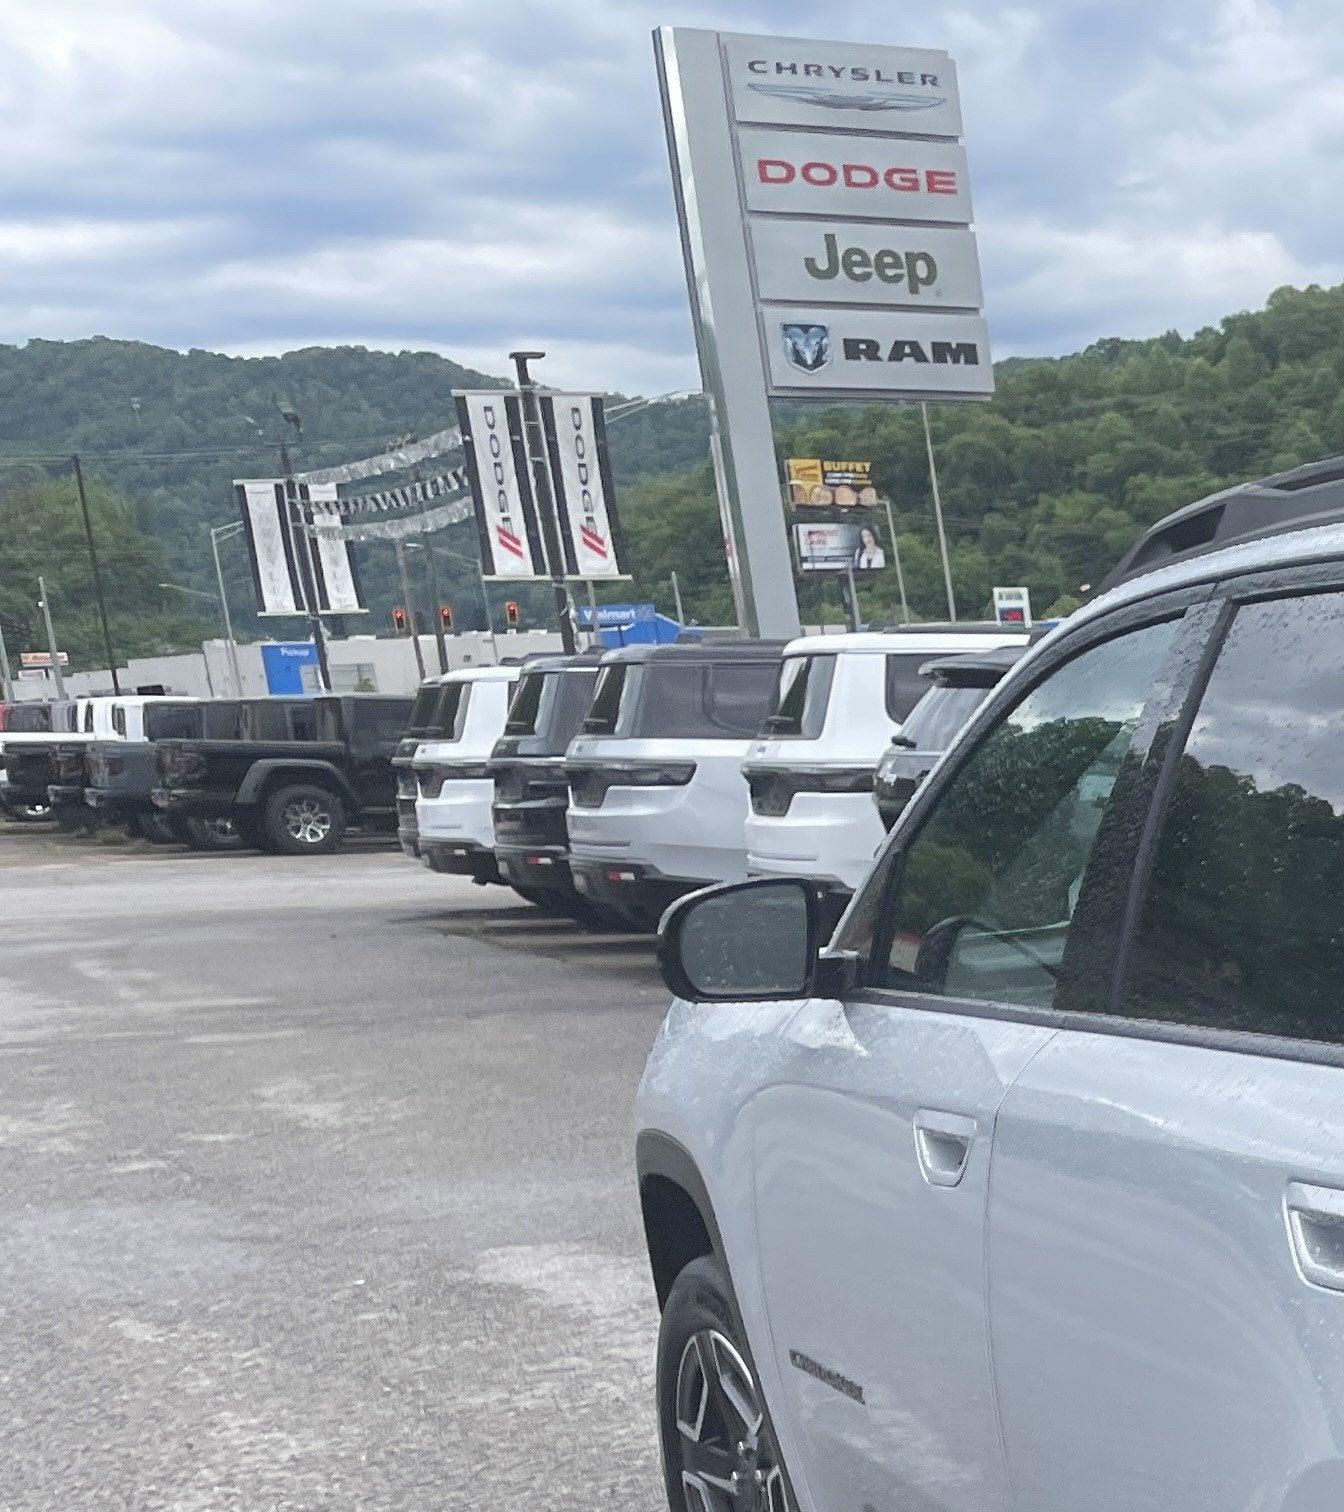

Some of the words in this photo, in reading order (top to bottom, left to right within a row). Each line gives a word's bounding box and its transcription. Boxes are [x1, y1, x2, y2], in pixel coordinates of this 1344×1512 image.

[747, 59, 940, 88] CHRYSLER
[756, 158, 958, 195] DODGE
[803, 232, 938, 295] Jeep
[841, 337, 979, 366] RAM
[483, 406, 514, 536] DODGE
[571, 407, 598, 536] DODGE
[823, 461, 871, 473] BUFFET
